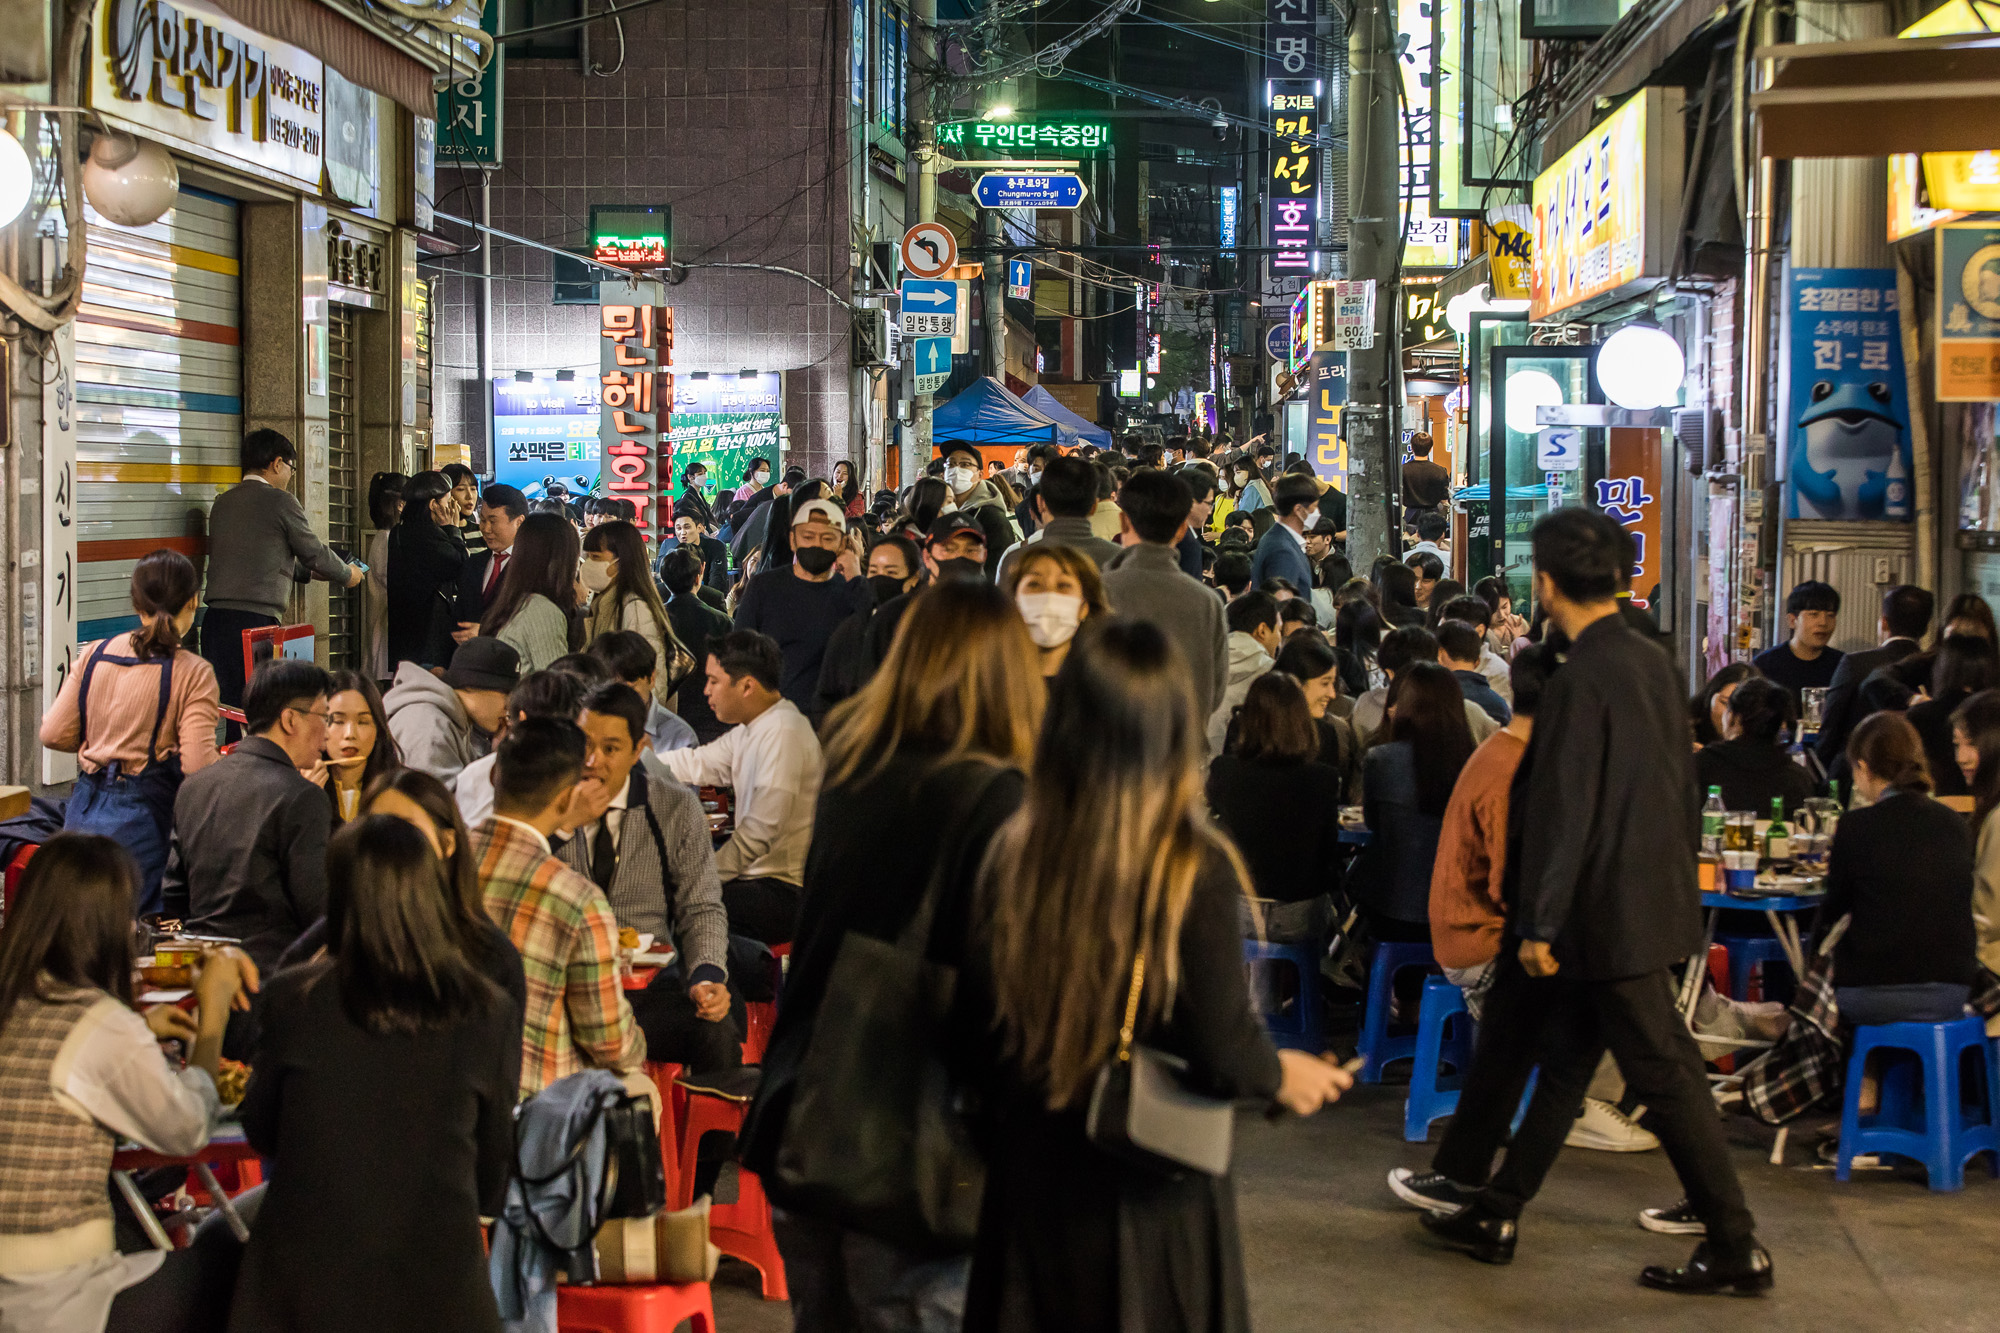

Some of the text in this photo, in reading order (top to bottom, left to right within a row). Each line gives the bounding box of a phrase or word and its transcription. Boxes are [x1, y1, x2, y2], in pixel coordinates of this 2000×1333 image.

[1272, 95, 1315, 110] 을지로
[975, 124, 1107, 147] 무인단속중입
[1007, 177, 1050, 189] 충무로9길
[983, 187, 989, 195] 8
[997, 190, 1059, 198] Chungmu-ro 9-gil
[1067, 187, 1077, 196] 12
[1274, 201, 1310, 267] 호프
[1406, 220, 1448, 244] 본점
[1336, 282, 1363, 297] 종로
[906, 315, 952, 333] 일방통행
[526, 397, 566, 409] to visit
[745, 431, 777, 447] 100%
[509, 441, 565, 462] 쏘맥은
